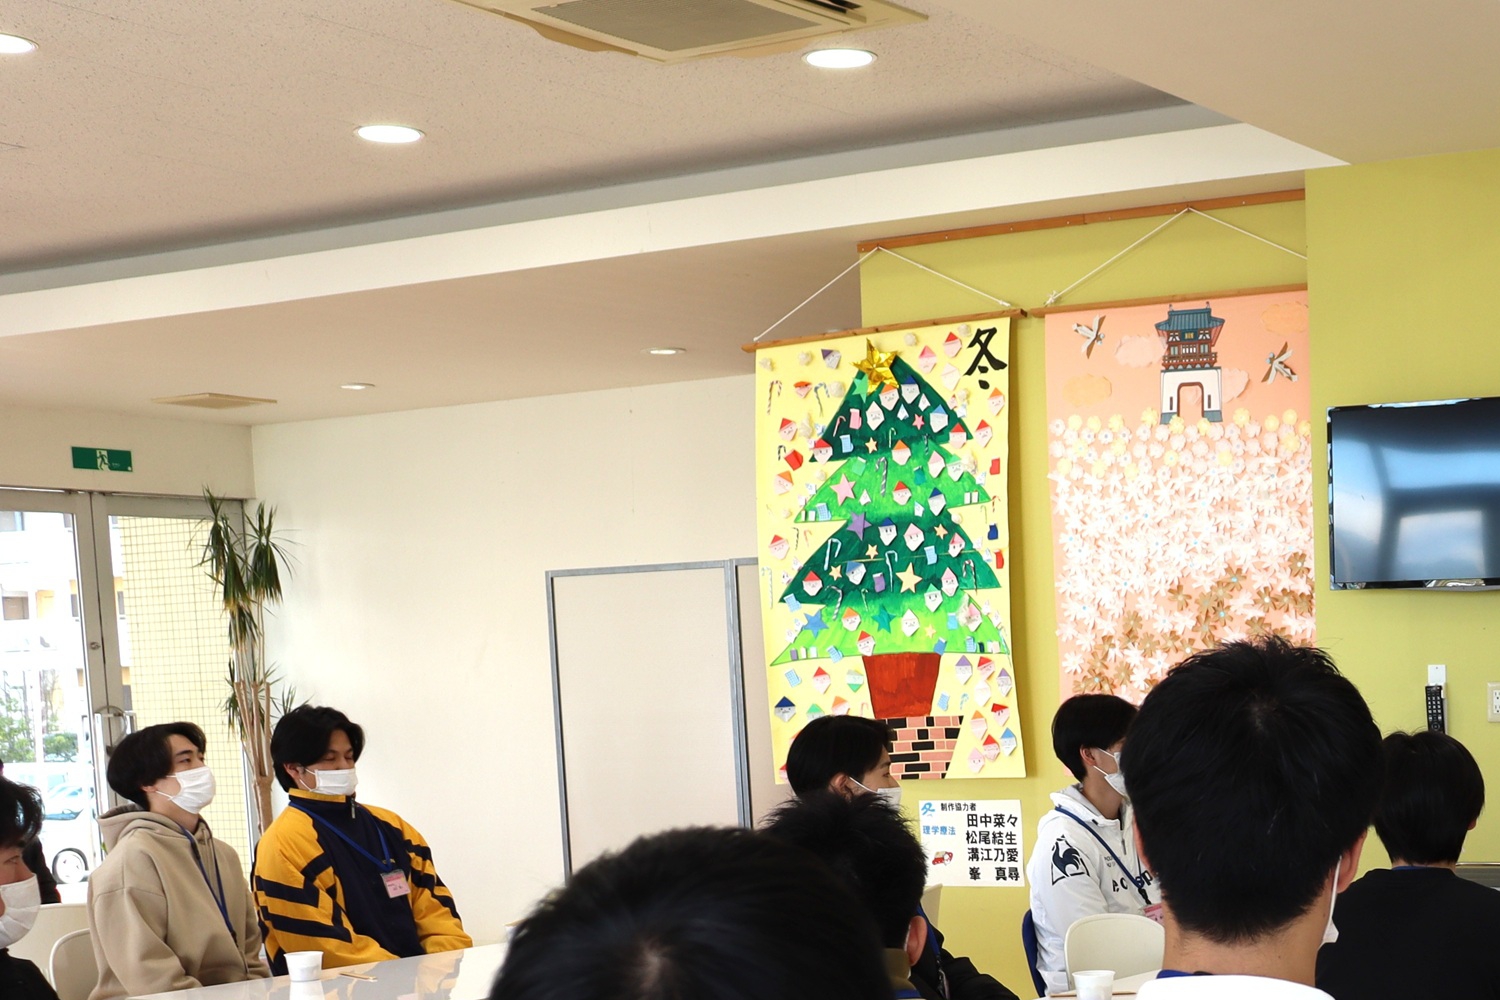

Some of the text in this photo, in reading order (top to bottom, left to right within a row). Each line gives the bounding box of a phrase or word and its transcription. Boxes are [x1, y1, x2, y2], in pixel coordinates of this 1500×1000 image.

[963, 326, 1008, 390] 冬
[940, 802, 977, 812] 制作協力者
[967, 813, 1018, 828] 田中菜々
[922, 825, 956, 836] 理学療法
[966, 830, 1018, 845] 松尾結生
[967, 847, 1019, 862] 溝江乃愛
